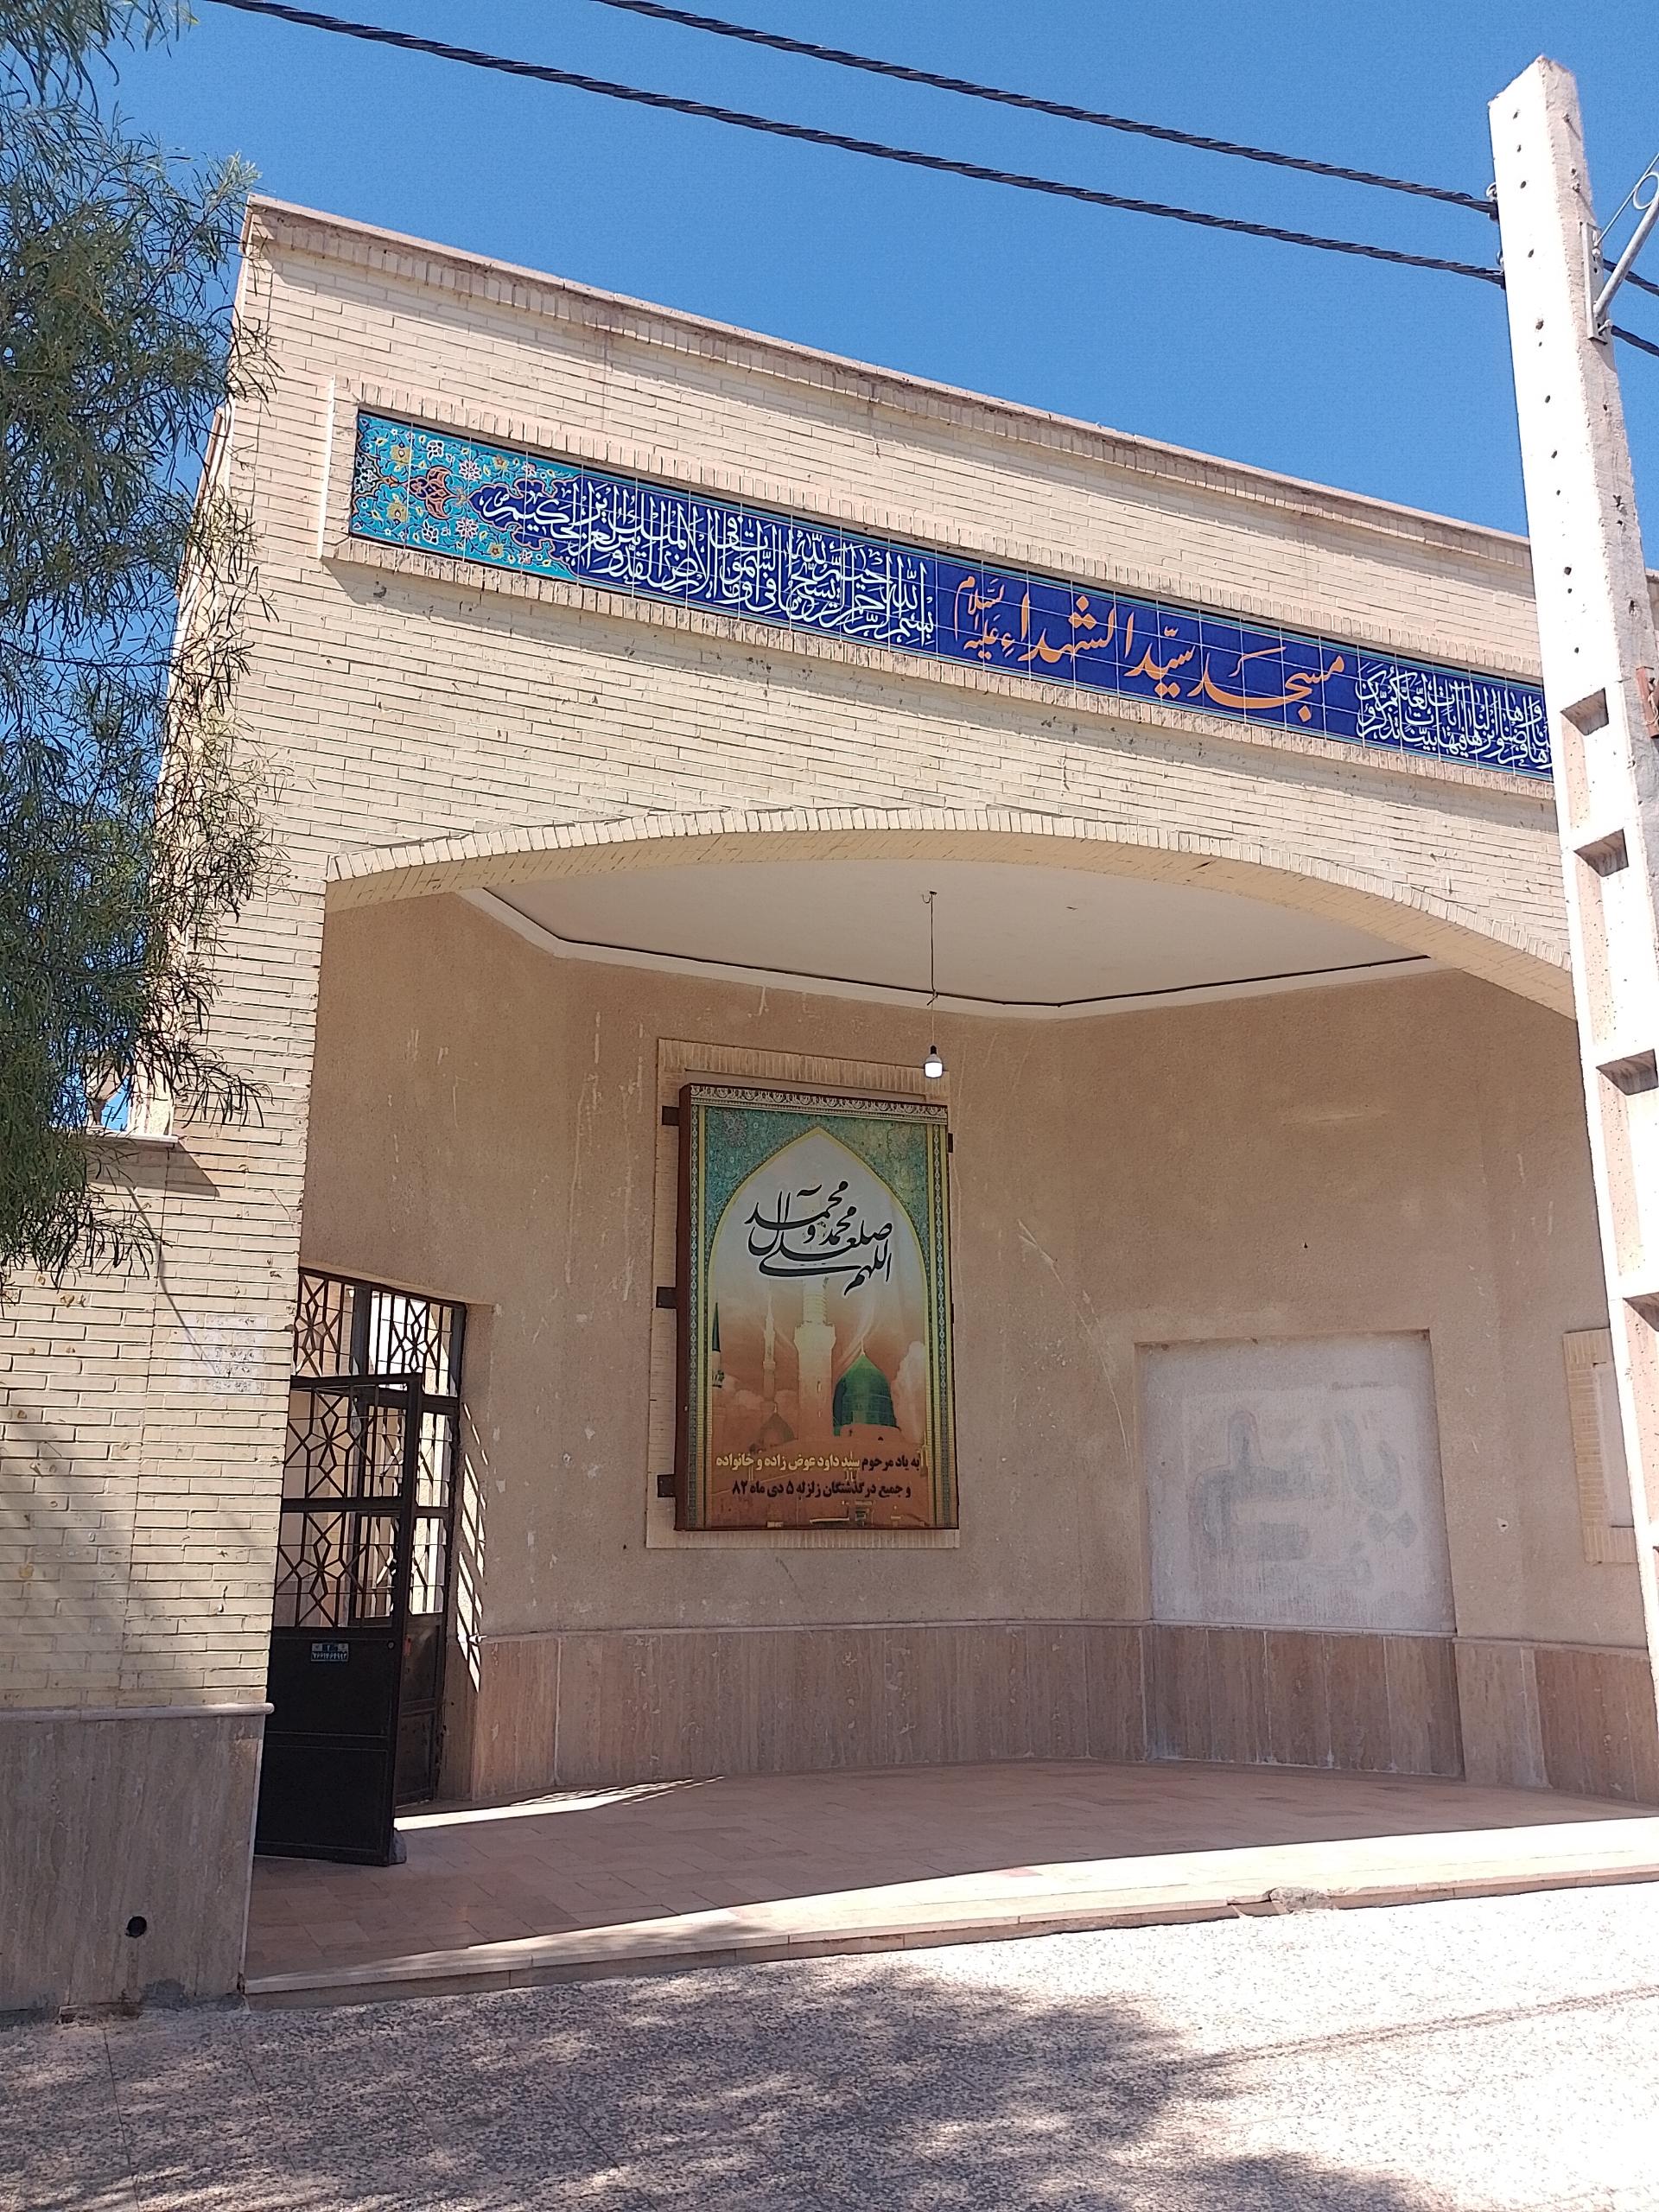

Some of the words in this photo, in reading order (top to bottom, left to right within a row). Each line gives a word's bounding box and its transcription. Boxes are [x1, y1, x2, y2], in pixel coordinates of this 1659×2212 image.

[1187, 648, 1344, 722] مسجد
[744, 1180, 849, 1230] محمد
[803, 1224, 817, 1244] و
[818, 1206, 857, 1246] محمد
[844, 1238, 893, 1296] اللهم
[715, 1452, 754, 1471] خانواده
[755, 1459, 763, 1471] و
[762, 1453, 787, 1471] زاده
[788, 1454, 816, 1471] عوض
[817, 1453, 839, 1471] داود
[841, 1457, 861, 1471] سید
[895, 1454, 909, 1471] یاد
[910, 1457, 920, 1471] به
[749, 1480, 766, 1494] ماه
[766, 1483, 785, 1497] دی
[785, 1480, 795, 1495] ۵
[878, 1485, 904, 1498] جمیع
[905, 1485, 912, 1498] و
